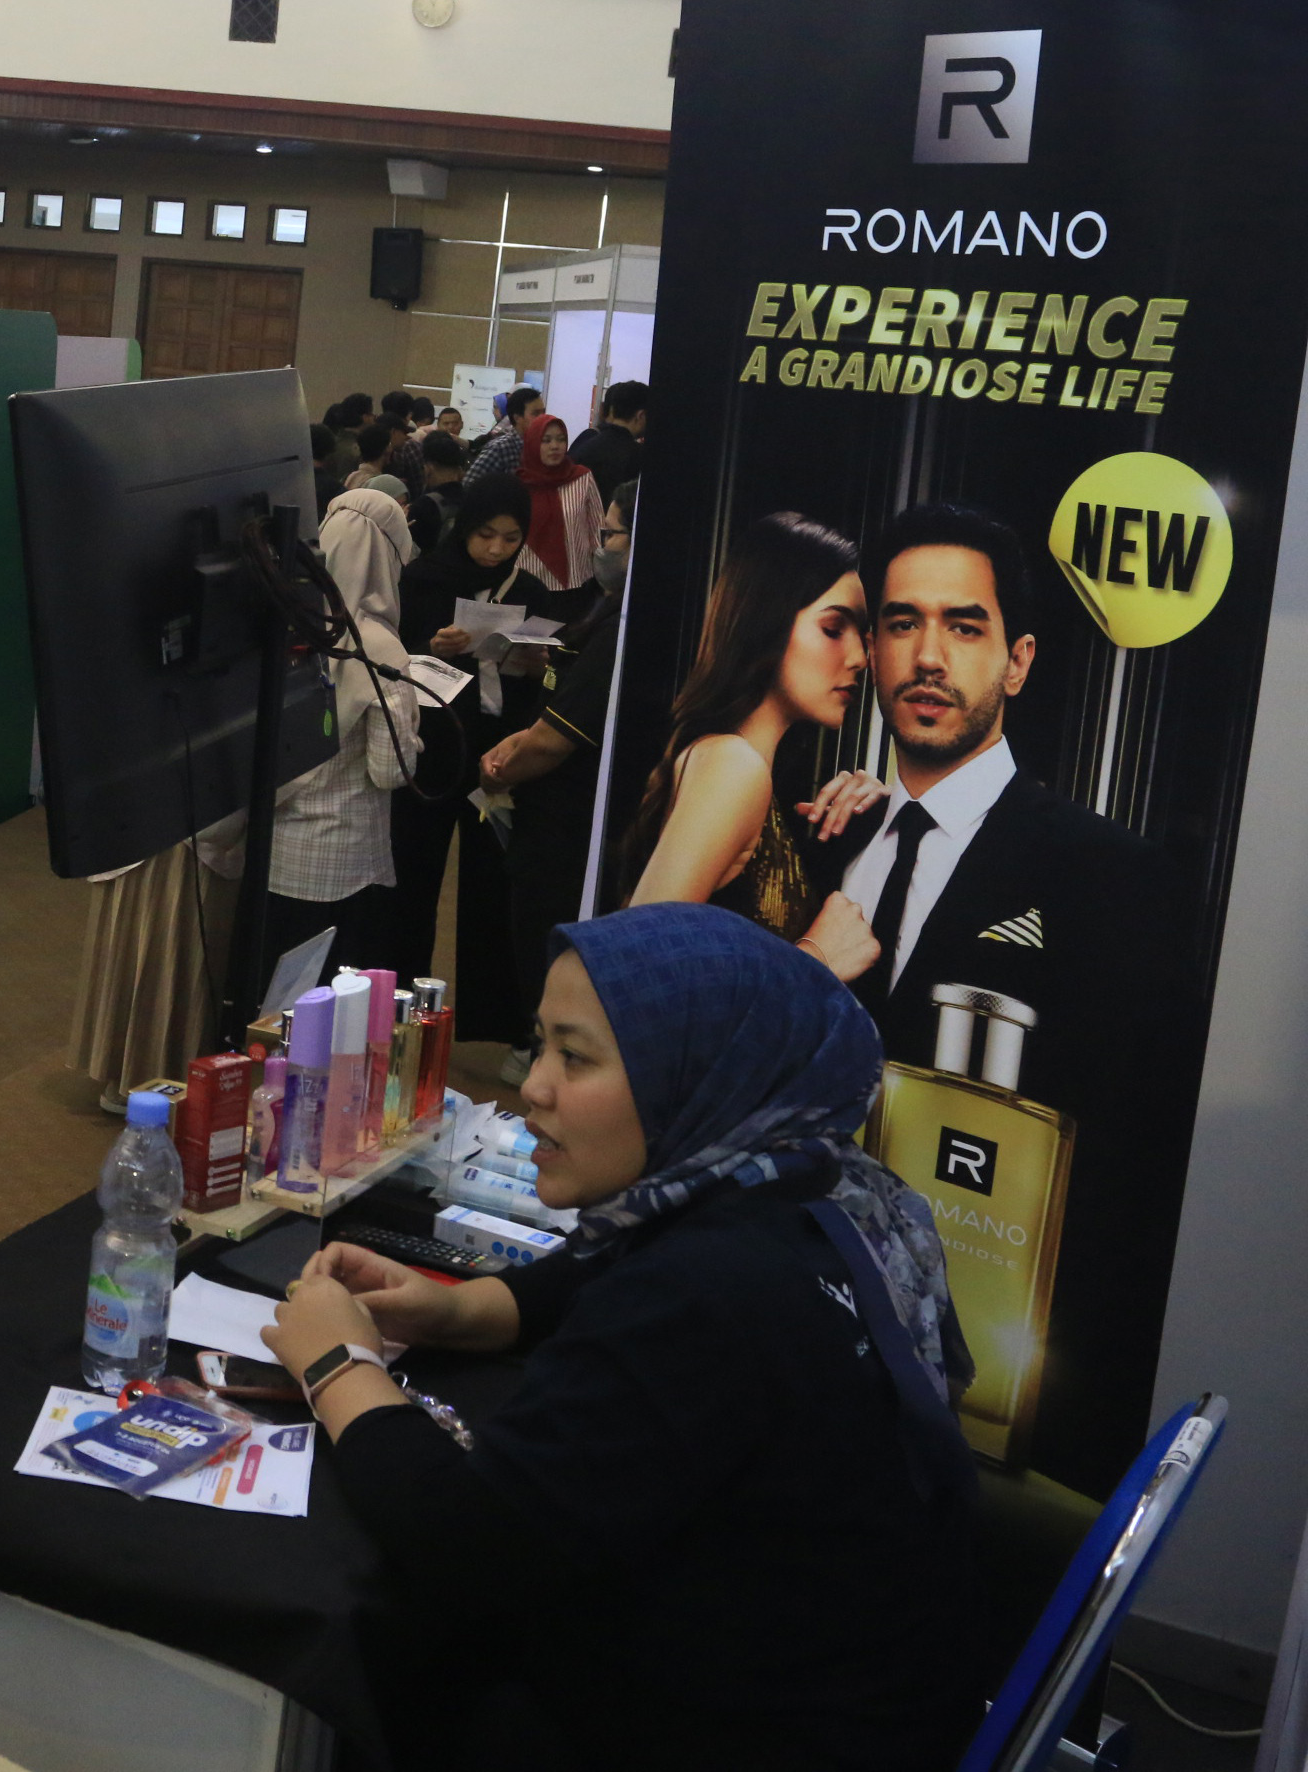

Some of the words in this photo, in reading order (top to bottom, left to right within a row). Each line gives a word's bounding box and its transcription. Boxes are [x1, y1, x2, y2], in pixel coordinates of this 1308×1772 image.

[937, 56, 1016, 140] R
[821, 208, 1108, 259] ROMANO
[746, 282, 1189, 362] EXPERIENCE
[740, 345, 768, 384] A
[779, 347, 1052, 404] GRANDIOSE
[1059, 366, 1174, 415] LIFE
[1071, 502, 1211, 593] NEW
[947, 1139, 987, 1184] R
[920, 1193, 1027, 1246] MANO
[94, 1298, 109, 1315] Le
[130, 1414, 208, 1449] undip
